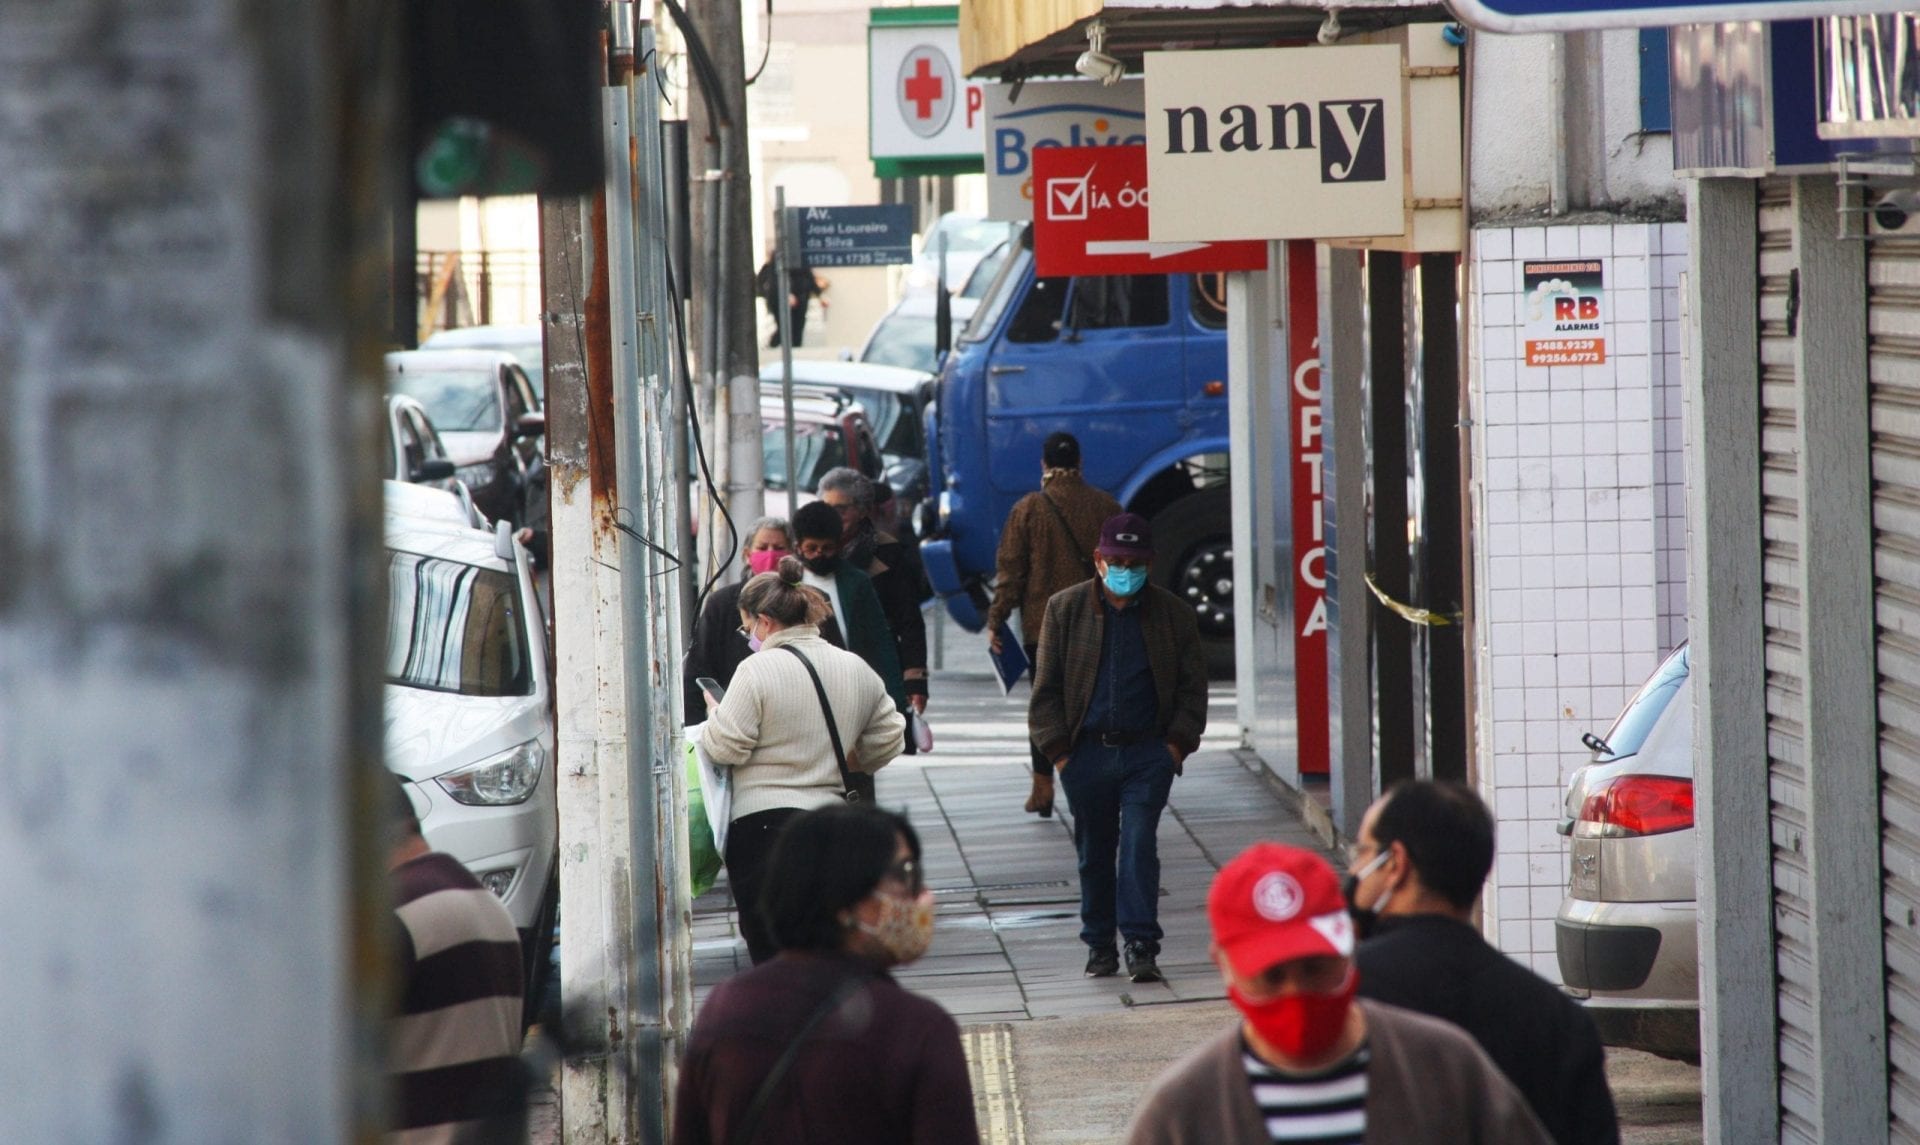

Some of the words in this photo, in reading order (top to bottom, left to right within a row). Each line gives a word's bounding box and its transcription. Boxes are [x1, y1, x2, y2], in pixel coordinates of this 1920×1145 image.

[1163, 99, 1384, 181] nany
[806, 207, 832, 220] Av.
[806, 222, 835, 234] José
[837, 222, 888, 233] Loureiro
[807, 237, 822, 248] da
[824, 236, 854, 248] Silva
[1555, 296, 1600, 321] RB
[1555, 323, 1599, 331] ALARMES
[1531, 353, 1599, 364] 99256.6773
